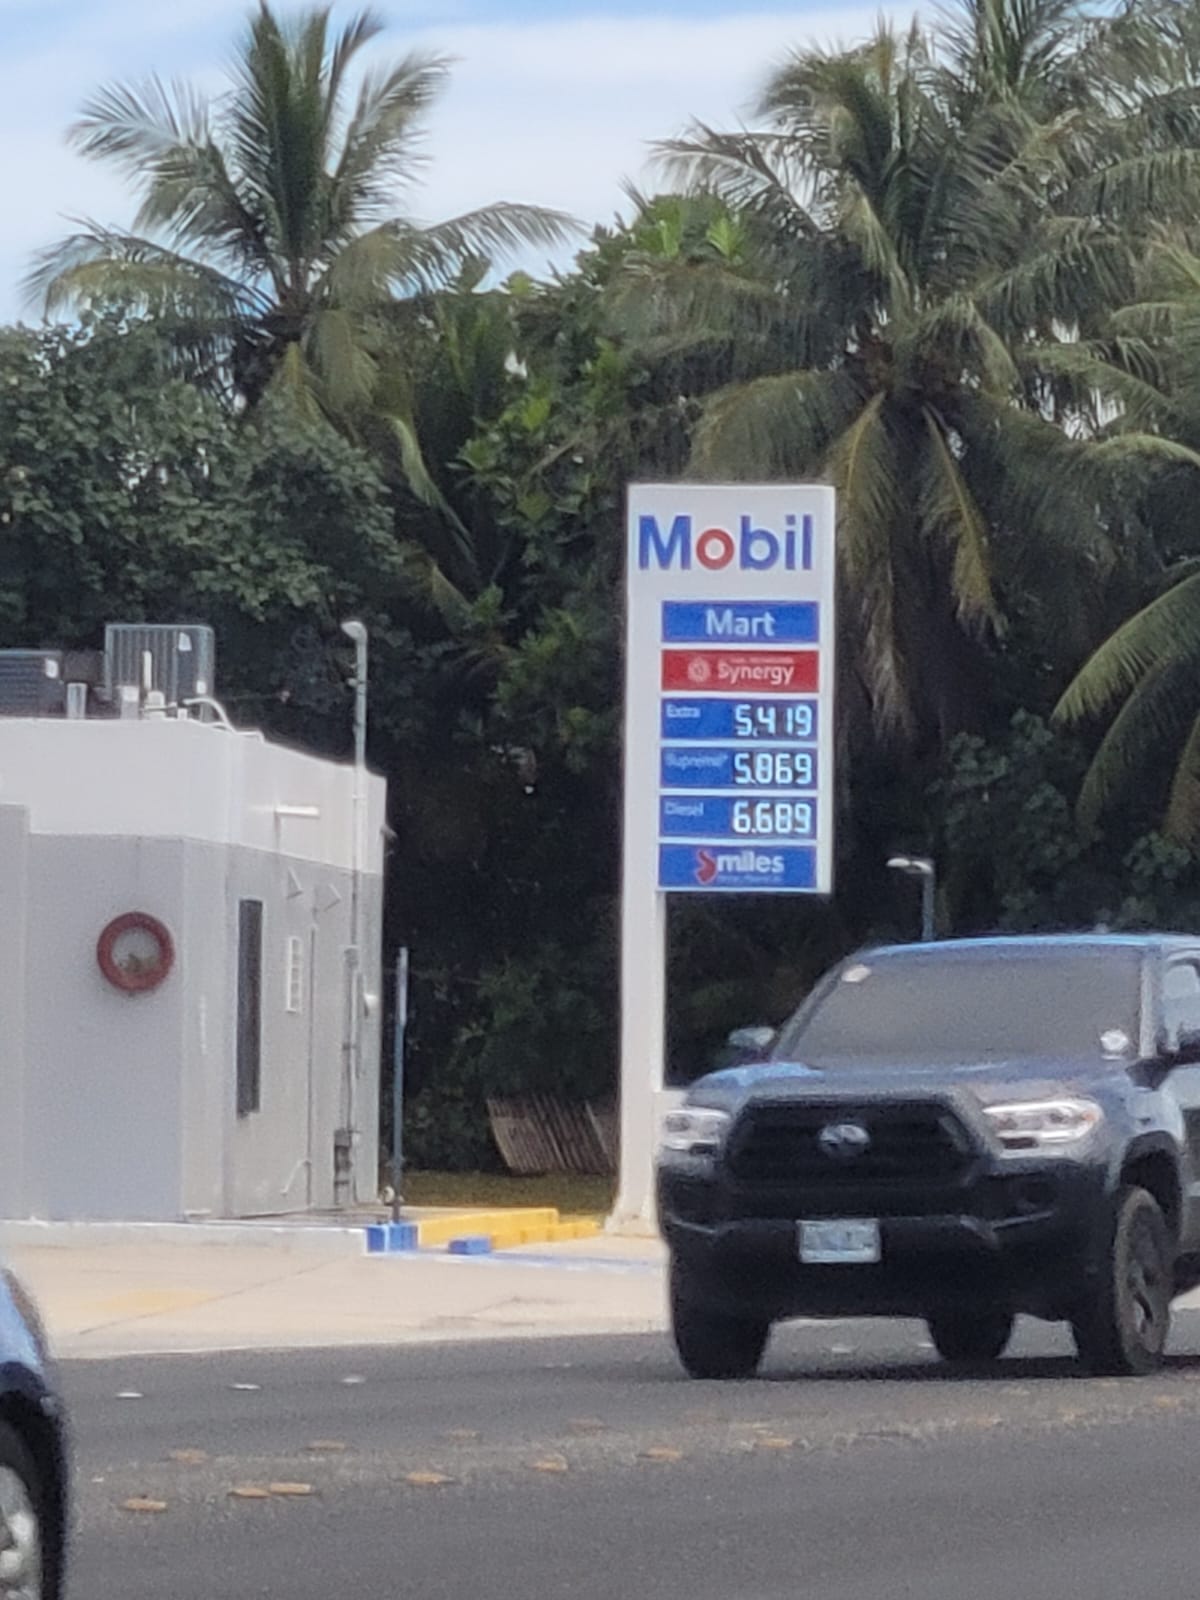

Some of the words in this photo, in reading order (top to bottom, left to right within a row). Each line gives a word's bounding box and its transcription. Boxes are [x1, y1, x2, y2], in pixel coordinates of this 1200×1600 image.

[638, 514, 813, 571] Mobil
[705, 608, 776, 636] Mart
[717, 659, 795, 685] Synergy
[735, 703, 812, 736] 5.419
